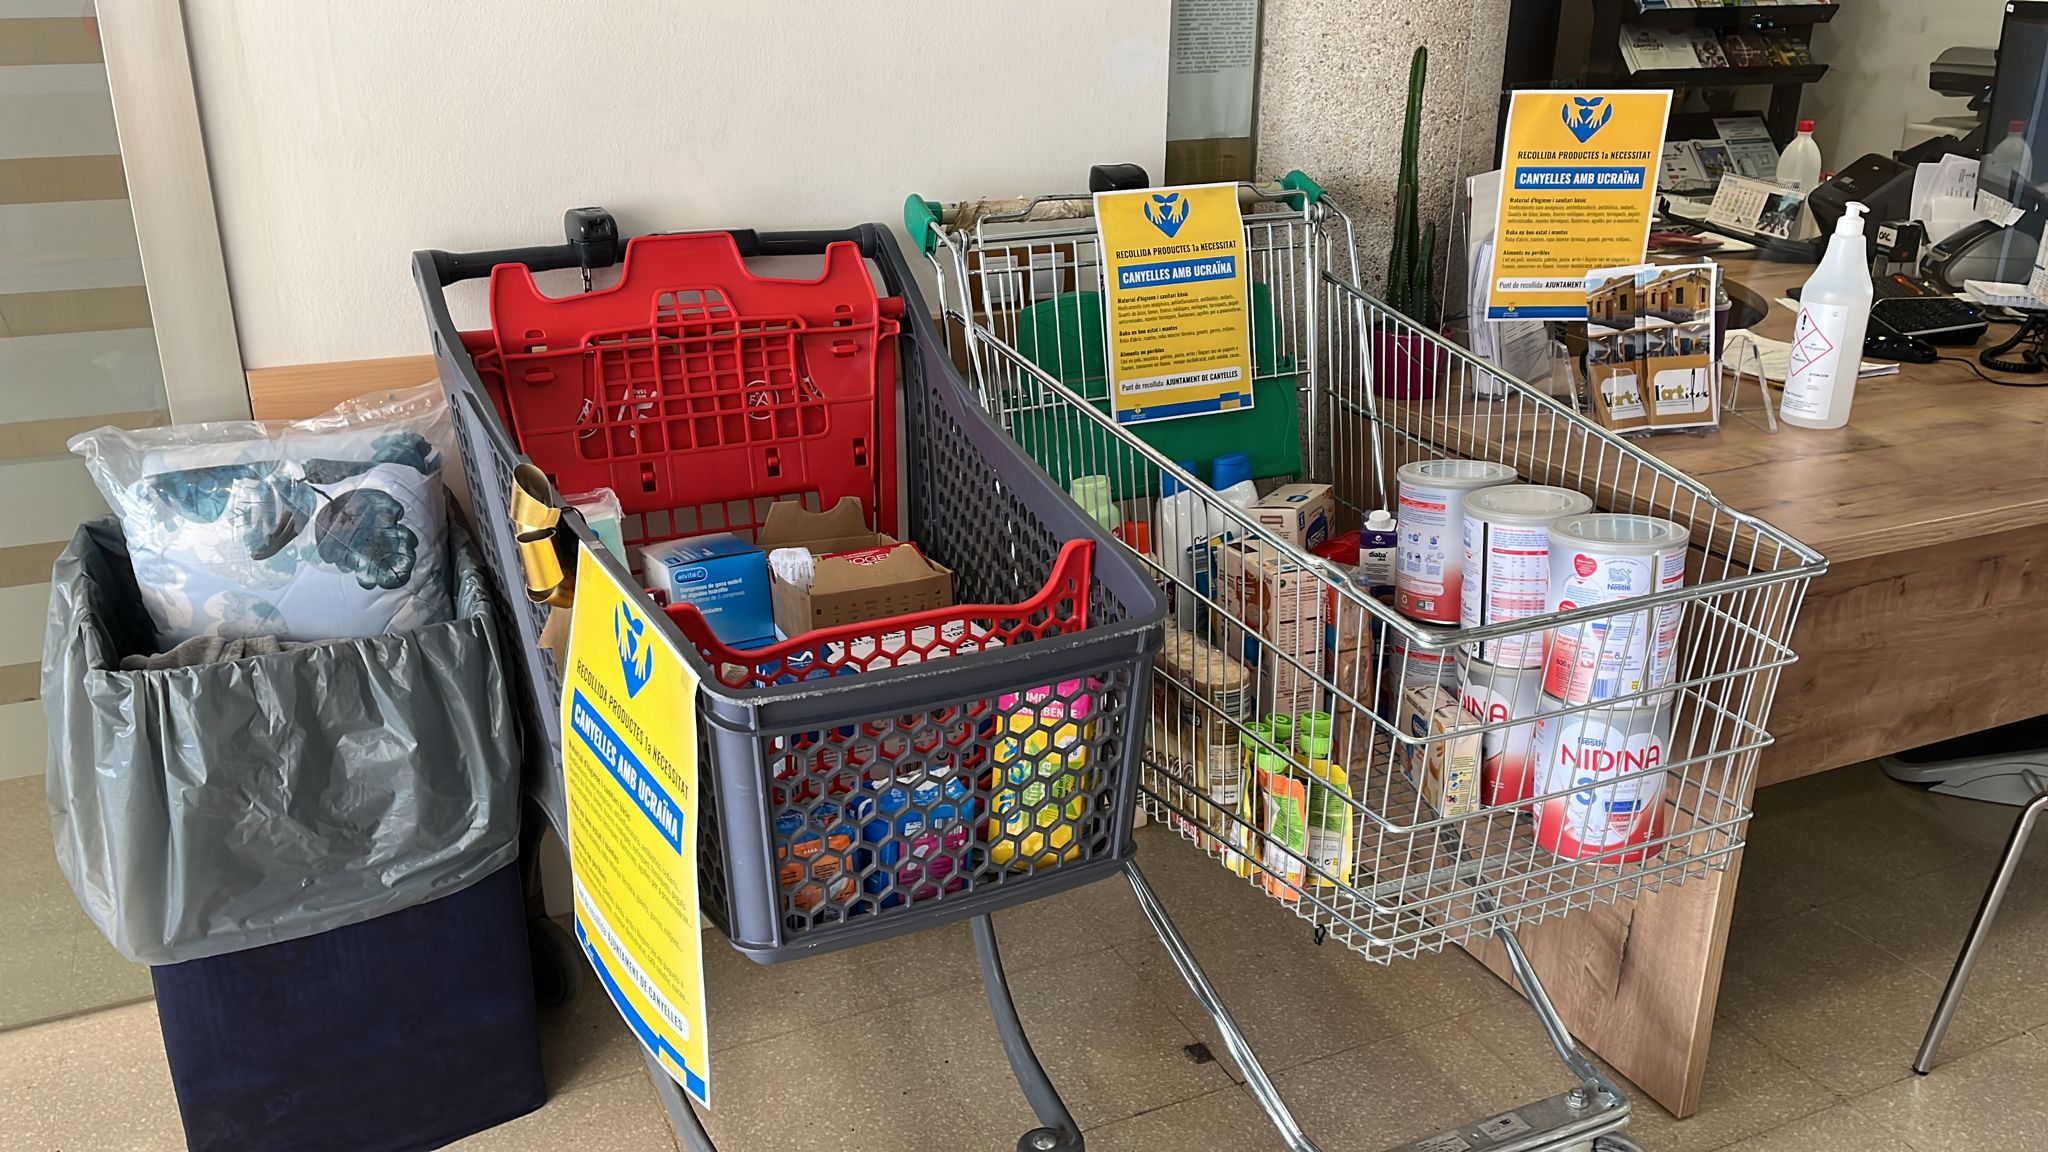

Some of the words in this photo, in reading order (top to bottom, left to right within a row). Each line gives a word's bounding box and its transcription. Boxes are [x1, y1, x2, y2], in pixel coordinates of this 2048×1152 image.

[1518, 152, 1556, 160] RECOLLIDA
[1558, 152, 1599, 160] PRODUCTES
[1601, 152, 1609, 160] 1a
[1611, 151, 1651, 160] NECESSITAT
[1520, 172, 1571, 185] CANYELLES
[1573, 173, 1595, 185] AMB
[1597, 170, 1640, 185] UCRAÏNA
[1116, 247, 1152, 260] RECOLLIDA
[1153, 244, 1191, 257] PRODUCTES
[1192, 243, 1200, 252] 1a
[1200, 240, 1236, 252] NECESSITAT
[1122, 268, 1170, 284] CANYELLES
[1172, 266, 1192, 279] AMB
[1194, 260, 1232, 277] UCRAÏNA
[1118, 296, 1136, 304] Material
[1122, 383, 1134, 392] Punt
[1135, 382, 1141, 390] de
[1166, 375, 1200, 386] AJUNTAMENT
[1202, 375, 1209, 383] DE
[1210, 370, 1238, 381] CANYELLES
[678, 572, 697, 580] alvita
[577, 660, 608, 704] RECOLLIDA
[608, 695, 644, 745] PRODUCTES
[645, 736, 652, 755] 1a
[653, 744, 689, 800] NECESSITAT
[1562, 744, 1660, 772] NIDINA
[574, 704, 617, 767] CANYELLES
[617, 754, 637, 791] AMB
[638, 776, 678, 842] UCRAÏNA
[1576, 778, 1597, 806] 3
[608, 932, 639, 978] AJUNTAMENT
[640, 975, 648, 993] DE
[649, 987, 683, 1032] CANYELLES
